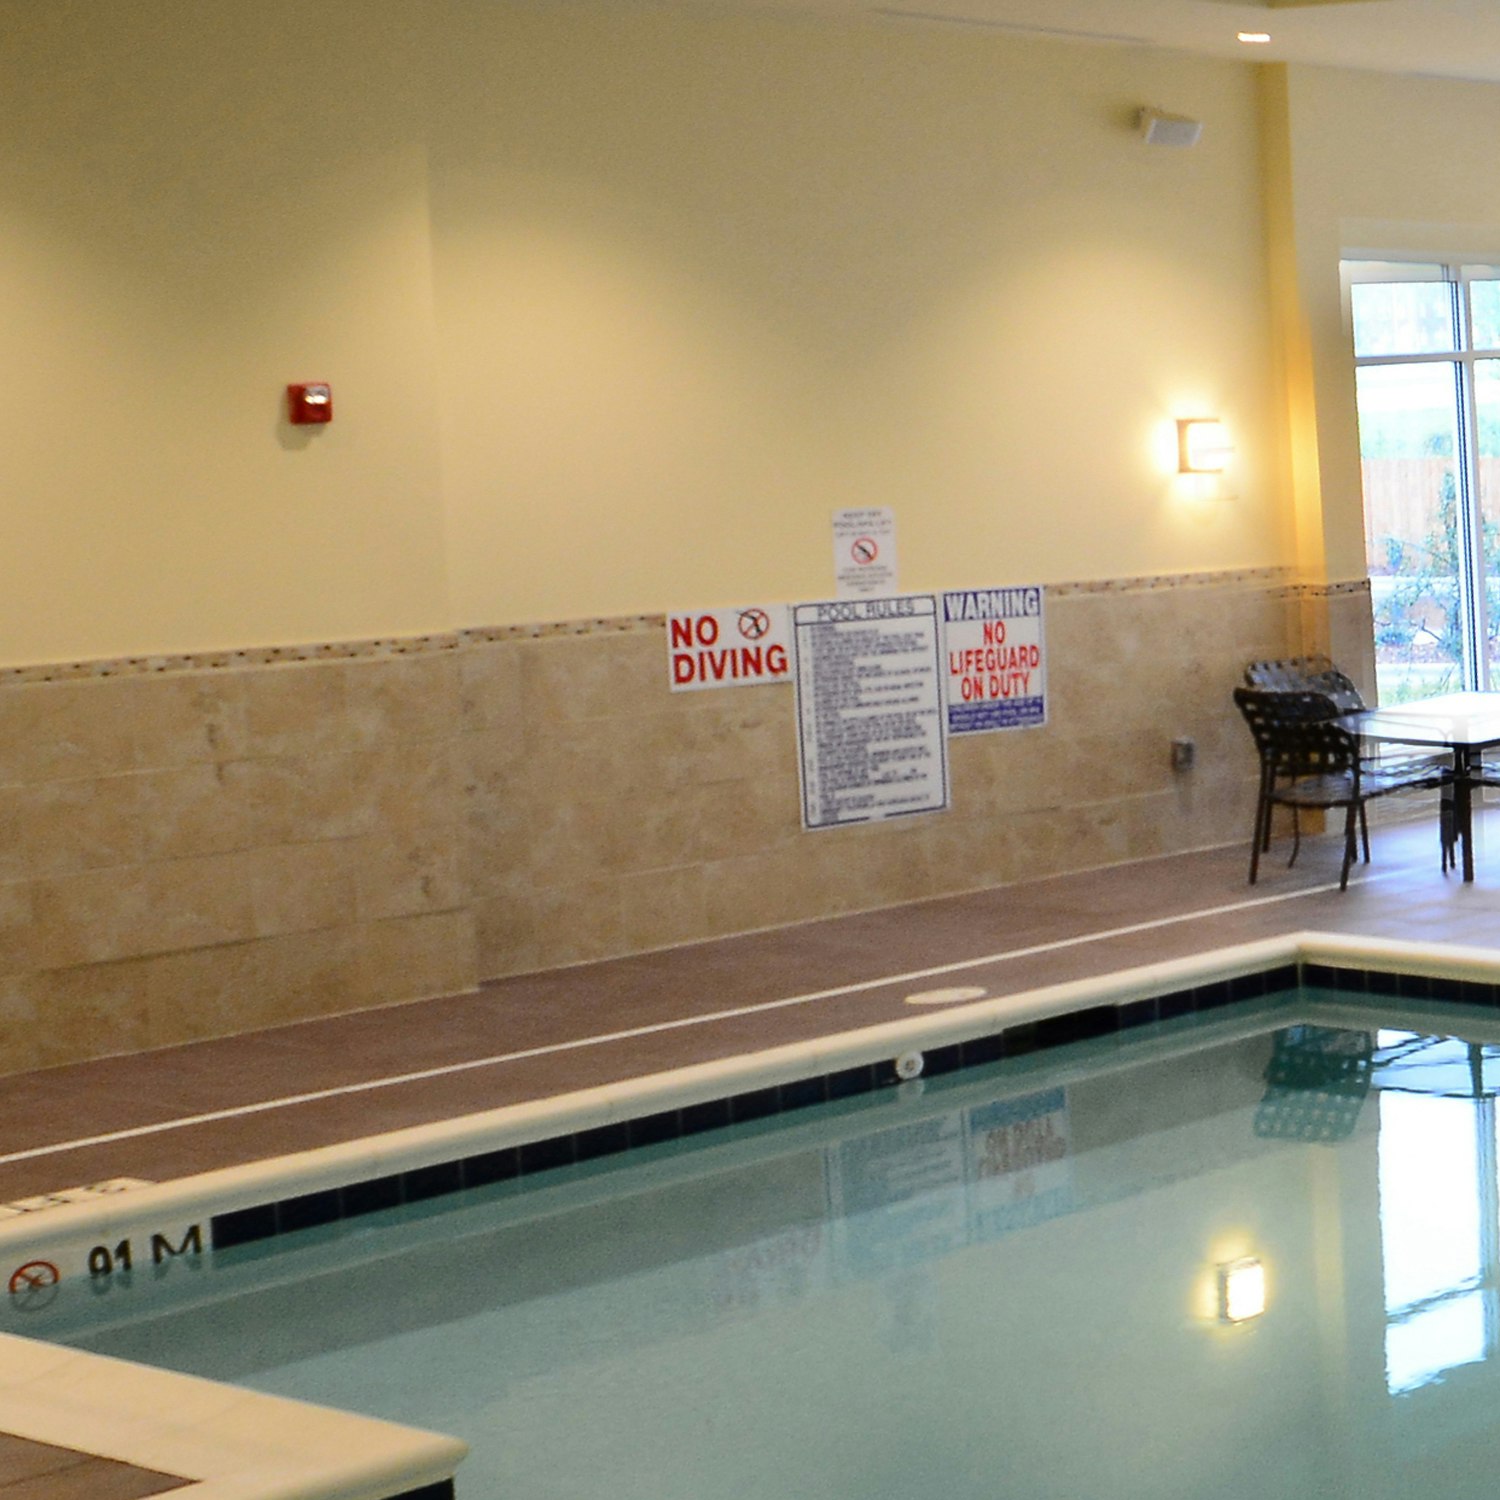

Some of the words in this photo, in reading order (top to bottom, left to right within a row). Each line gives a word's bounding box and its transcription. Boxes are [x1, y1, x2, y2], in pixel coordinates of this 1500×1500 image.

[818, 603, 862, 621] POOL
[866, 599, 914, 618] RULES
[945, 589, 1038, 620] WARNING
[671, 615, 719, 648] NO
[984, 620, 1006, 645] NO
[673, 644, 788, 685] DIVING
[949, 645, 1040, 675] LIFEGUARD
[961, 676, 984, 701] ON
[989, 672, 1031, 698] DUTY
[151, 1224, 202, 1264] M
